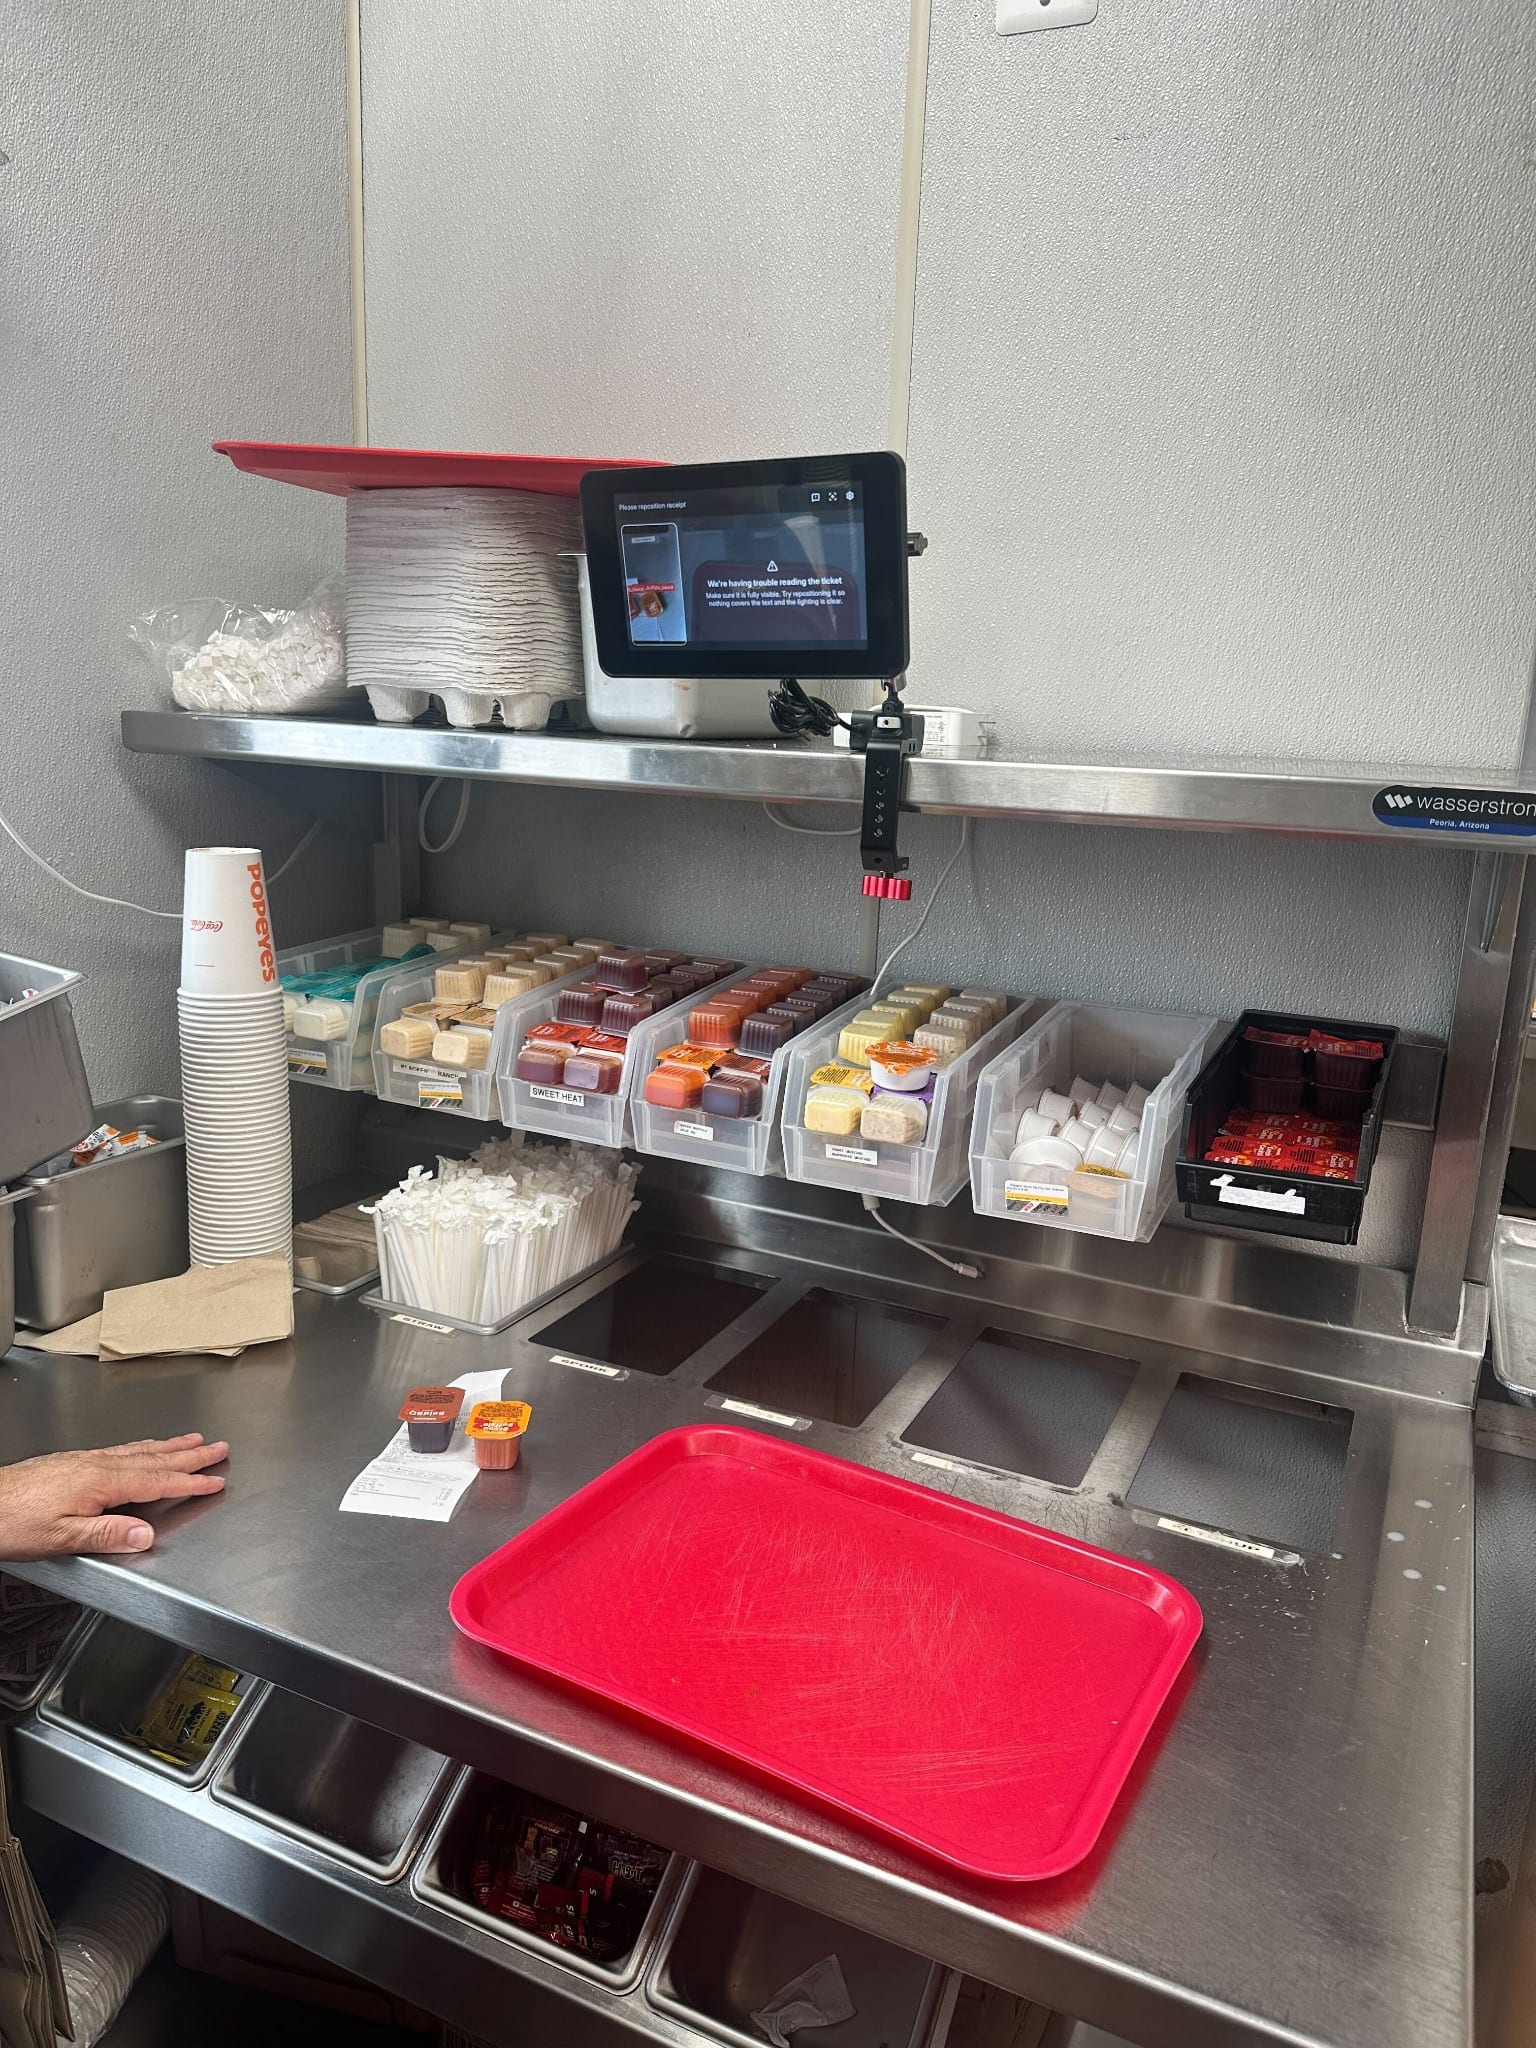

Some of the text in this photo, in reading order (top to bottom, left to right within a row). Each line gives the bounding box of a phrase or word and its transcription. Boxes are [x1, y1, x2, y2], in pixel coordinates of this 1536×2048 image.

[618, 501, 687, 511] Please reposition receipt
[707, 577, 842, 589] We're having trouble reading the ticket
[747, 591, 760, 600] fully
[782, 590, 792, 599] Try
[792, 589, 831, 599] repositioning
[708, 600, 730, 608] nothing
[761, 599, 773, 607] text
[797, 598, 819, 606] lighting
[1429, 818, 1490, 830] Peoria, Arizona
[532, 1087, 583, 1103] SWEET HEAT
[401, 1316, 445, 1331] STRAW
[560, 1358, 608, 1374] SPORK
